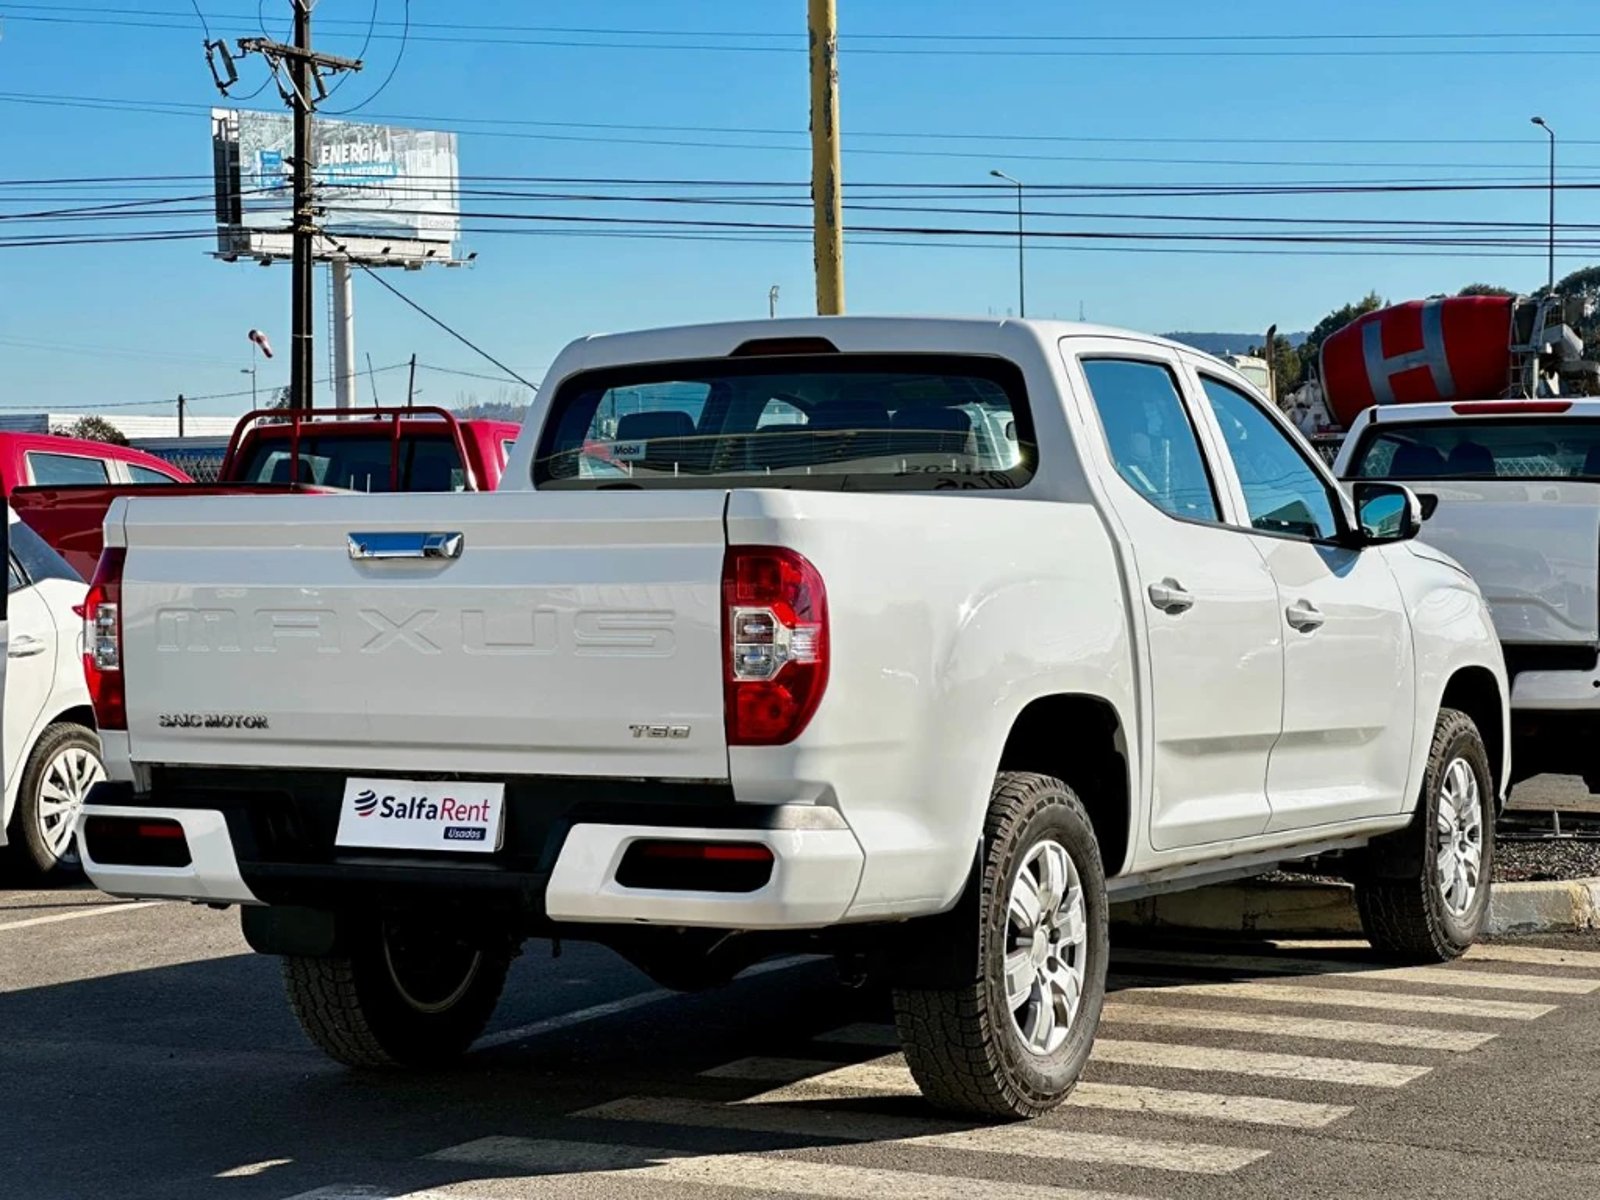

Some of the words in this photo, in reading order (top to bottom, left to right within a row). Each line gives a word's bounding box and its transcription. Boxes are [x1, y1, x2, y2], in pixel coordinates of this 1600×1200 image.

[1361, 299, 1456, 405] H
[613, 444, 641, 456] Mobil
[155, 606, 677, 658] MAXUS
[158, 713, 202, 728] SAIC
[204, 714, 269, 729] MOTOR
[379, 795, 491, 823] SalfaRent
[447, 828, 482, 840] Usados
